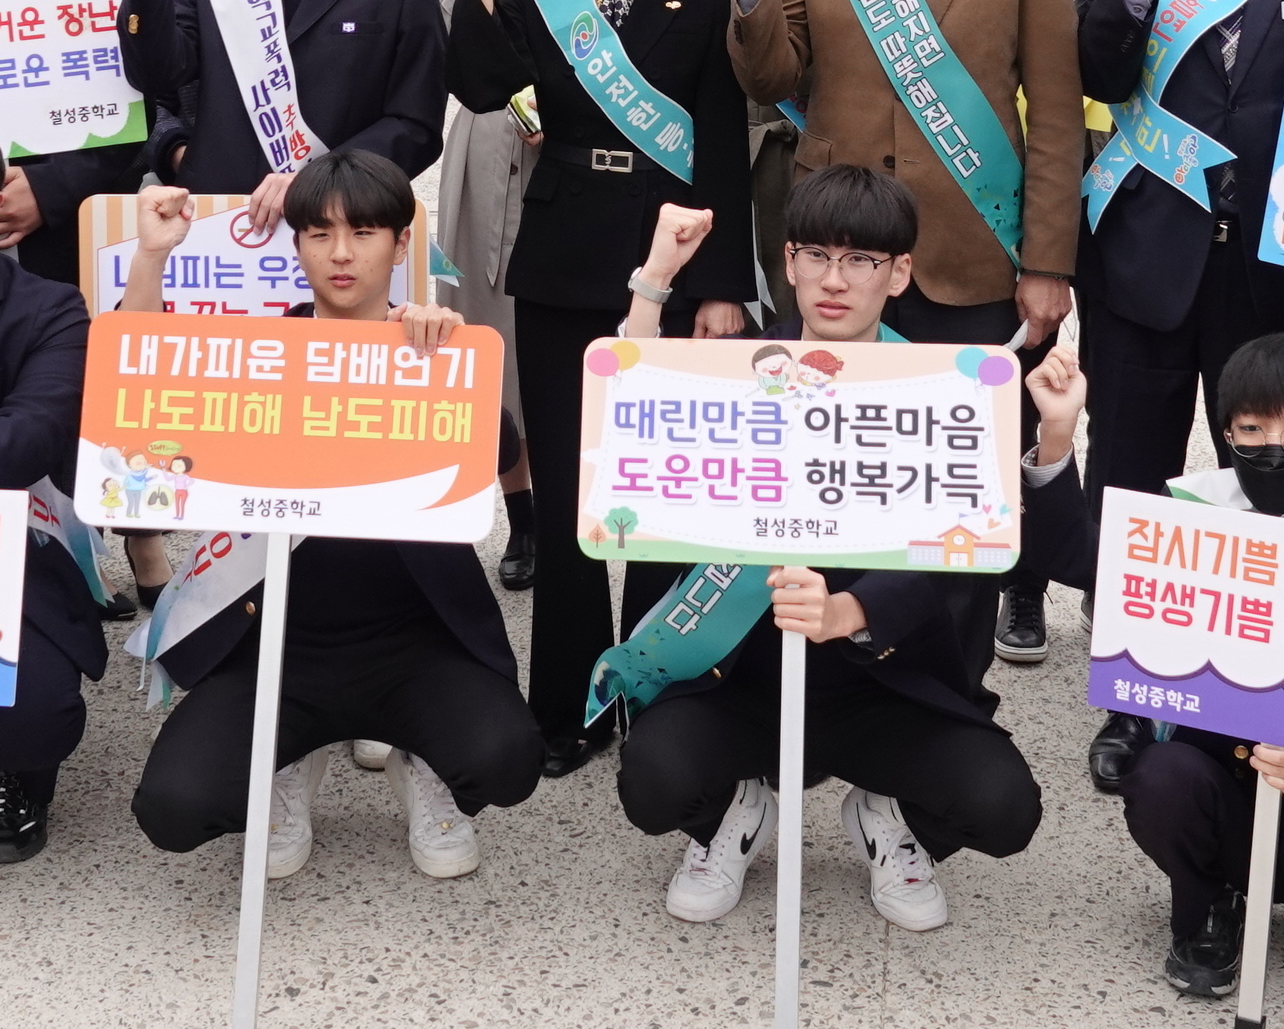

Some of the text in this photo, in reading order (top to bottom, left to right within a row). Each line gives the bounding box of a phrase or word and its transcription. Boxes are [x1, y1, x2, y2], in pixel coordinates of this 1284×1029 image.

[61, 46, 121, 82] 폭력
[48, 102, 119, 126] 철성중학교
[119, 334, 286, 381] 내가피운
[114, 388, 473, 444] 나도피해 남도피해
[614, 399, 985, 451] 때린만큼 아픈마음
[612, 454, 985, 509] 도운만큼 행복가득
[239, 497, 322, 518] 철성중학교
[752, 518, 839, 538] 철성중학교
[1127, 517, 1279, 586] 잠시기쁨
[1121, 572, 1274, 644] 평생기쁨
[1113, 678, 1200, 714] 철성중학교
